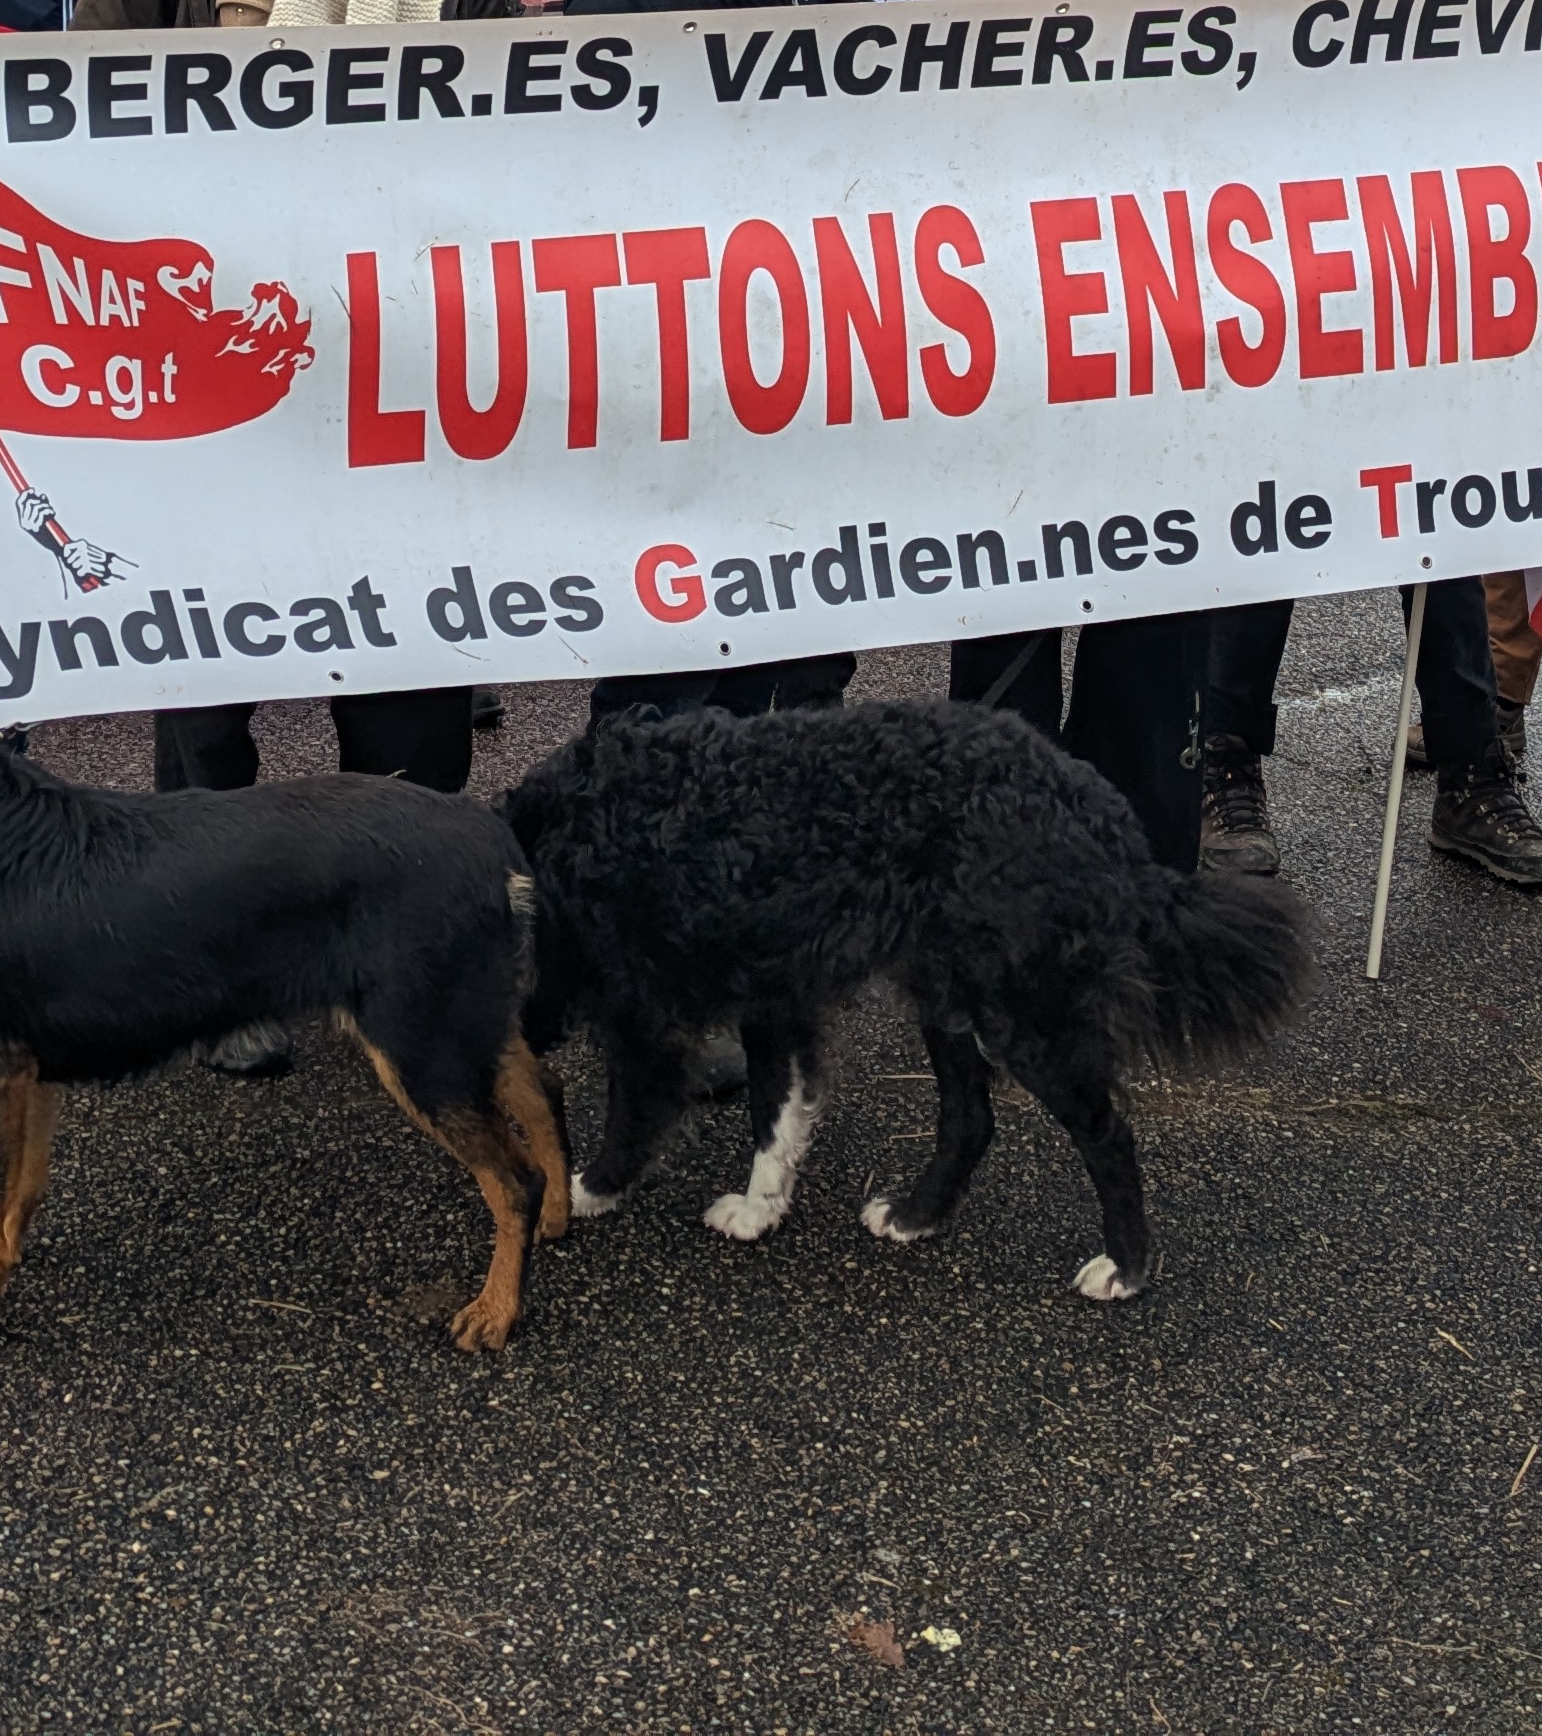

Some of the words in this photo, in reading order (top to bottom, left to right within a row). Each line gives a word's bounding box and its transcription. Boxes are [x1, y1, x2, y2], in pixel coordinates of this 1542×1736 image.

[4, 36, 659, 143] BERGER.ES,
[704, 6, 1258, 103] VACHER.ES,
[21, 344, 177, 419] C.g.t
[346, 205, 996, 468] LUTTONS
[425, 566, 604, 641] des
[634, 505, 1199, 624] Gardien.nes
[1230, 480, 1333, 556] de
